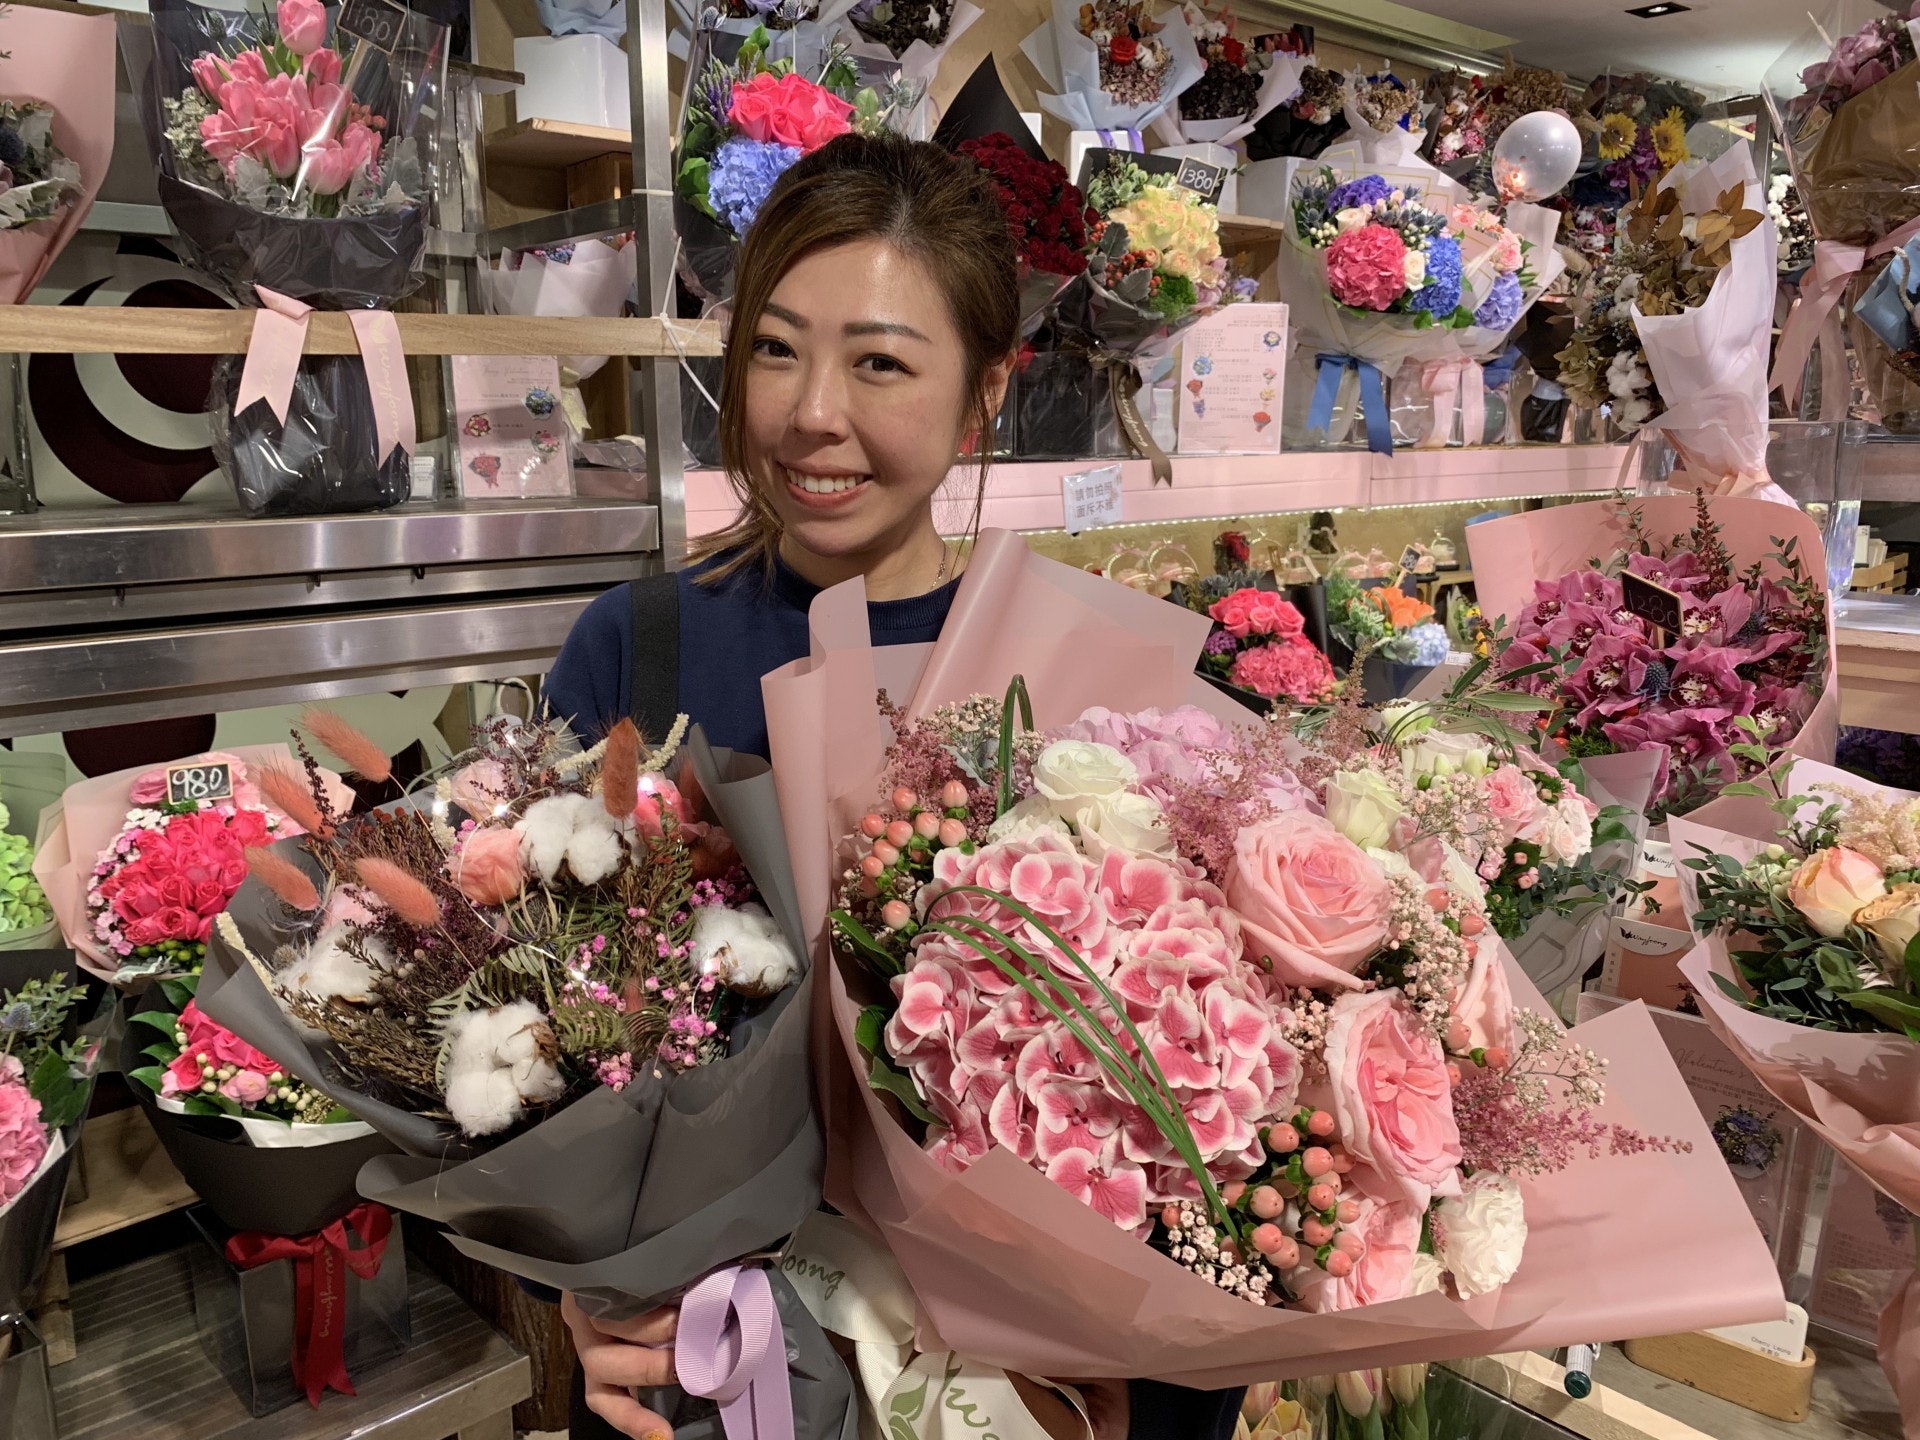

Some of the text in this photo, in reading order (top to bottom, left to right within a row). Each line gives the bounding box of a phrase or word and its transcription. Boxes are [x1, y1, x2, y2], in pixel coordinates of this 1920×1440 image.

[346, 0, 391, 41] 1180
[1180, 167, 1213, 190] 1380
[1628, 589, 1679, 628] 1280
[172, 766, 223, 799] 980
